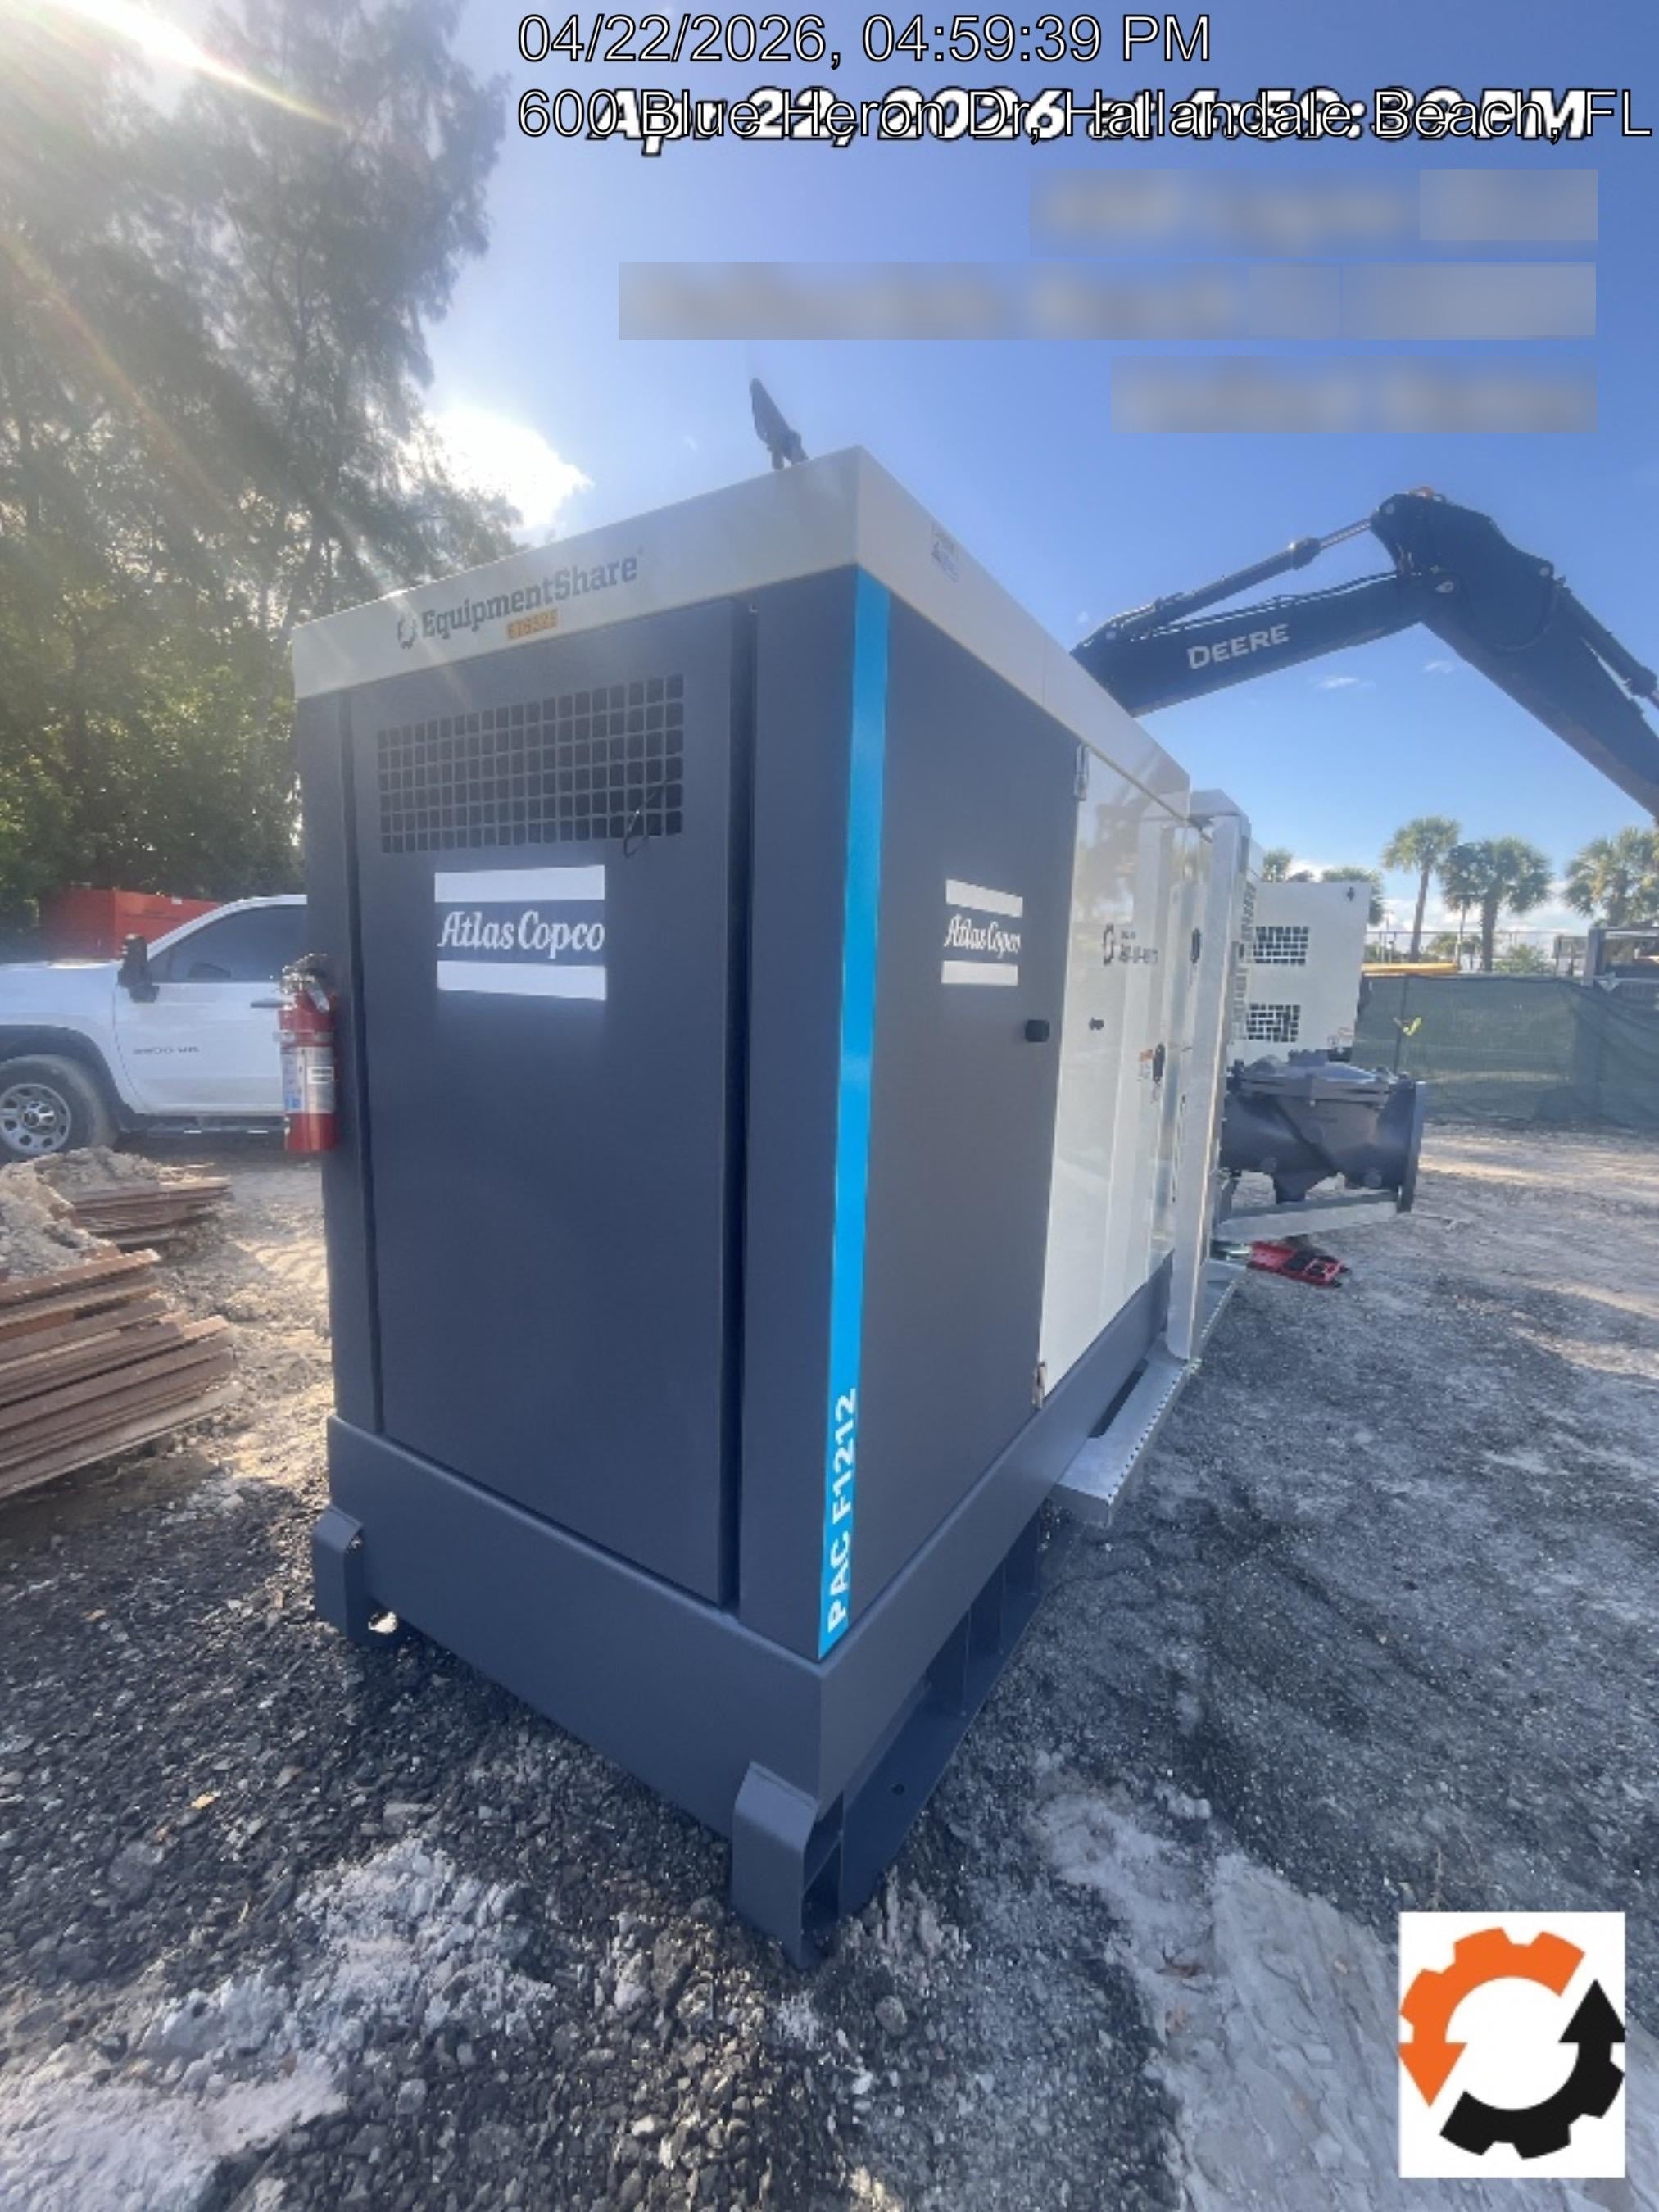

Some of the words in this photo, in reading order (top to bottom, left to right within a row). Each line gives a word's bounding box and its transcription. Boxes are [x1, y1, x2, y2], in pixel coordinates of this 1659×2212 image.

[421, 556, 637, 641] EquipmentShare
[1186, 623, 1290, 669] DEERE
[437, 910, 514, 950] Atlas
[518, 909, 605, 959] Copco
[832, 1388, 857, 1525] F1212
[827, 1530, 850, 1633] PAC
